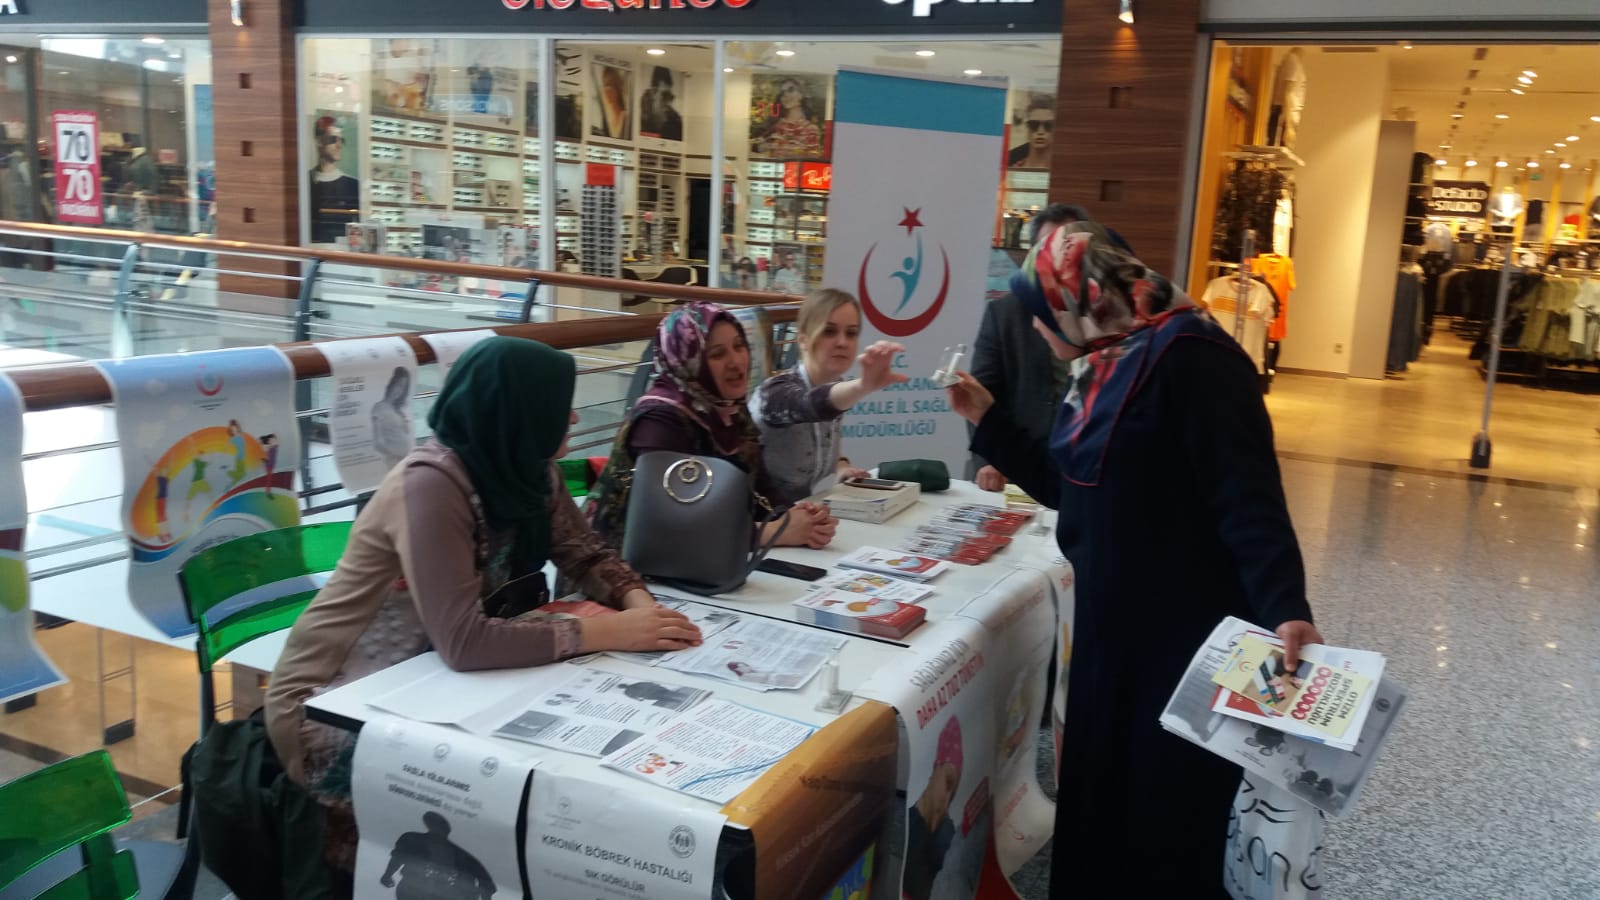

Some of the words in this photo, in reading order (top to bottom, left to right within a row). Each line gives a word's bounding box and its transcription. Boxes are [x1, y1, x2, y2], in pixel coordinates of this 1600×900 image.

[62, 129, 91, 161] 70
[62, 168, 95, 202] 70
[912, 396, 951, 413] SAĞL
[841, 419, 937, 438] MÜDÜRLÜĞÜ
[541, 834, 583, 855] KRONİK
[584, 845, 632, 868] BÖBREK
[633, 858, 693, 885] HASTALIĞI
